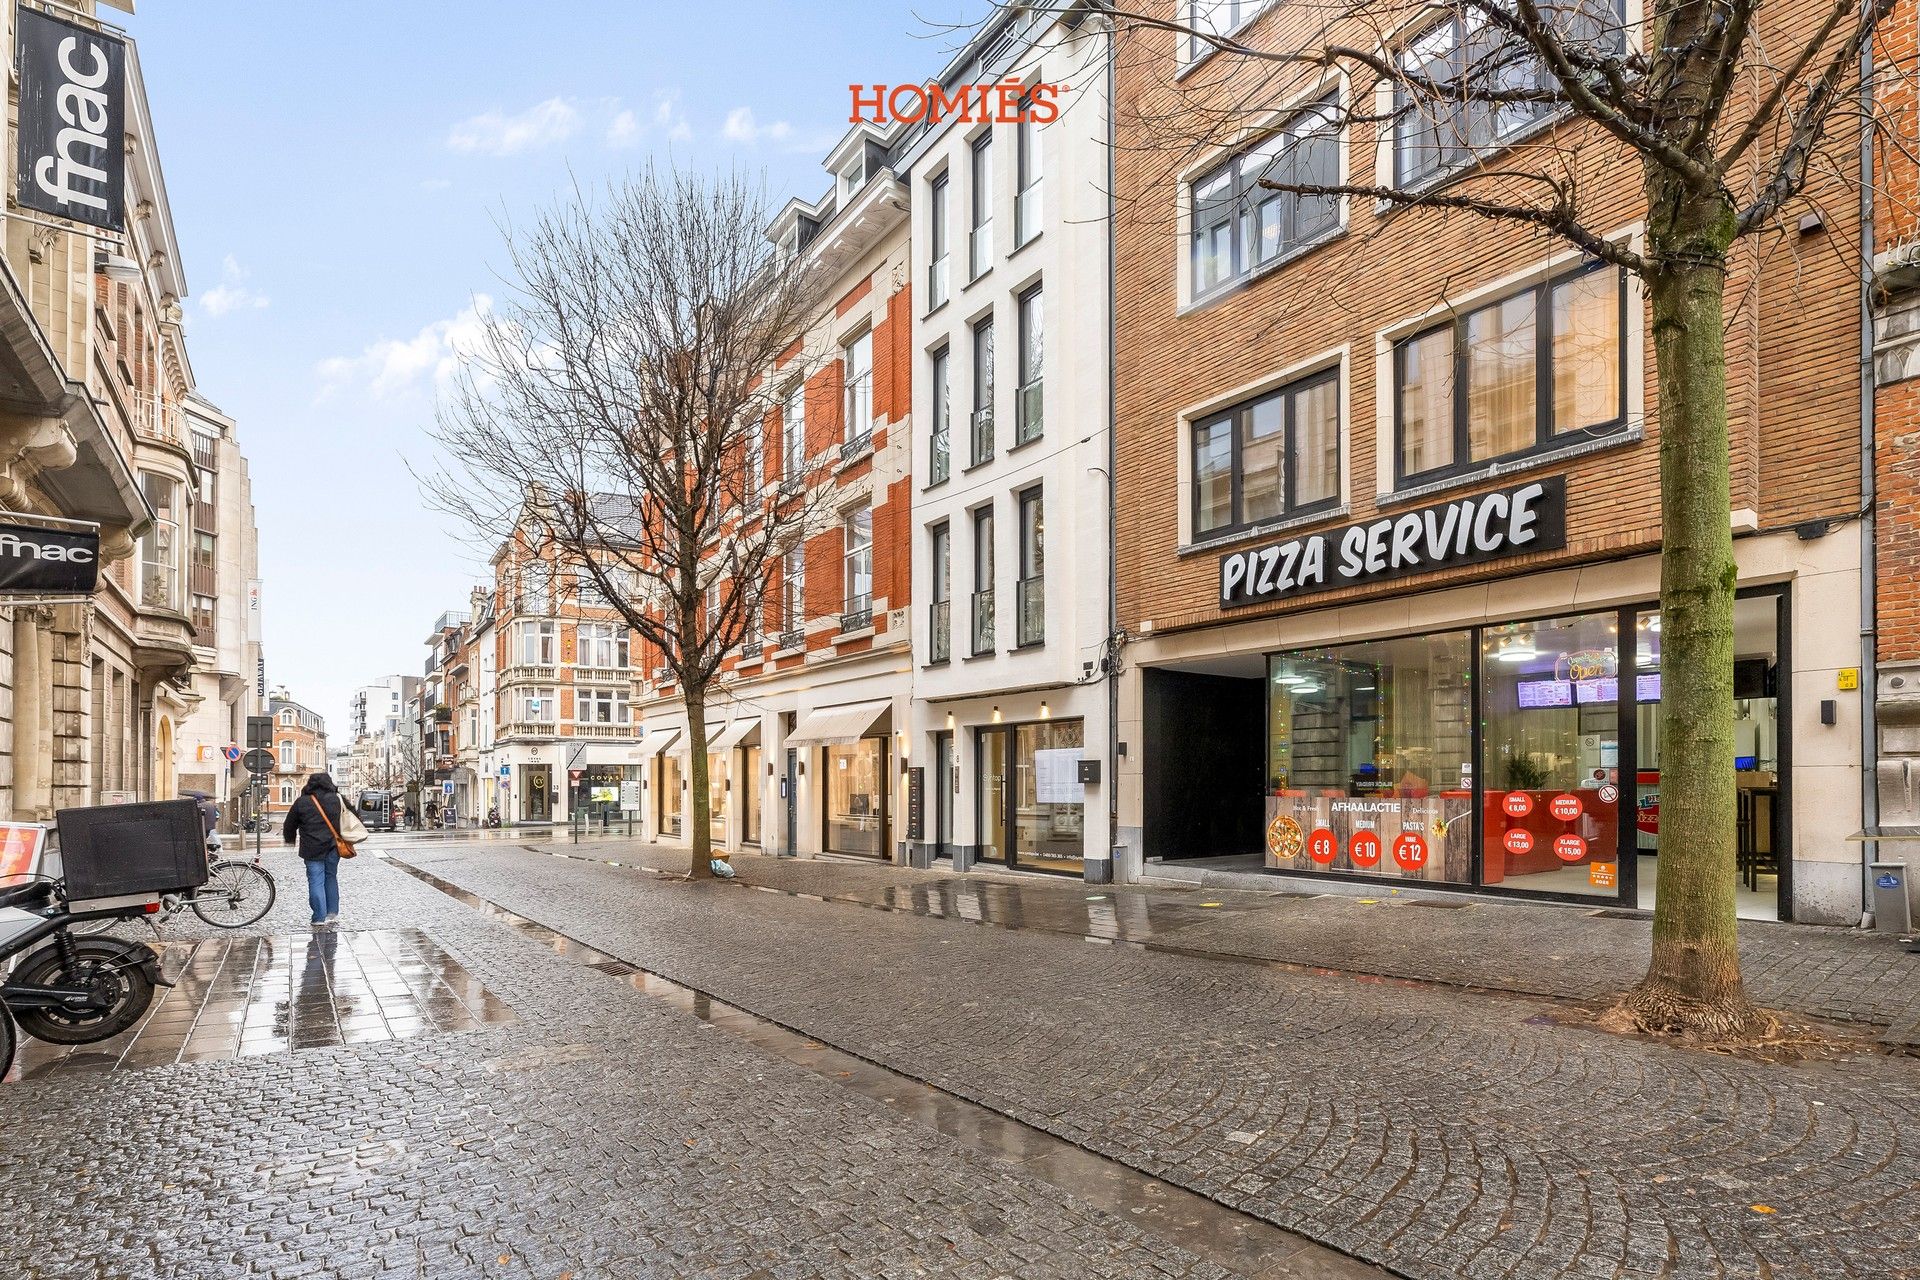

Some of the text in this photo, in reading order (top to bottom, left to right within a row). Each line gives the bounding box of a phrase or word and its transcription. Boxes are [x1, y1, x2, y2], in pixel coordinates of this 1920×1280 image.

[35, 36, 109, 210] fnac
[0, 533, 94, 564] fnac
[1222, 483, 1544, 601] PIZZA SERVICE
[1570, 663, 1605, 681] Open
[1331, 802, 1401, 813] AFHAALACTIE
[1513, 804, 1527, 812] 8,00
[1560, 807, 1578, 815] 10,00
[1355, 819, 1375, 829] MEDIUM
[1402, 821, 1425, 831] PASTA'S
[1314, 839, 1330, 855] € 8
[1355, 841, 1376, 858] € 10
[1512, 841, 1529, 849] 13,00
[1564, 847, 1581, 855] 15,00
[1399, 844, 1421, 861] € 12
